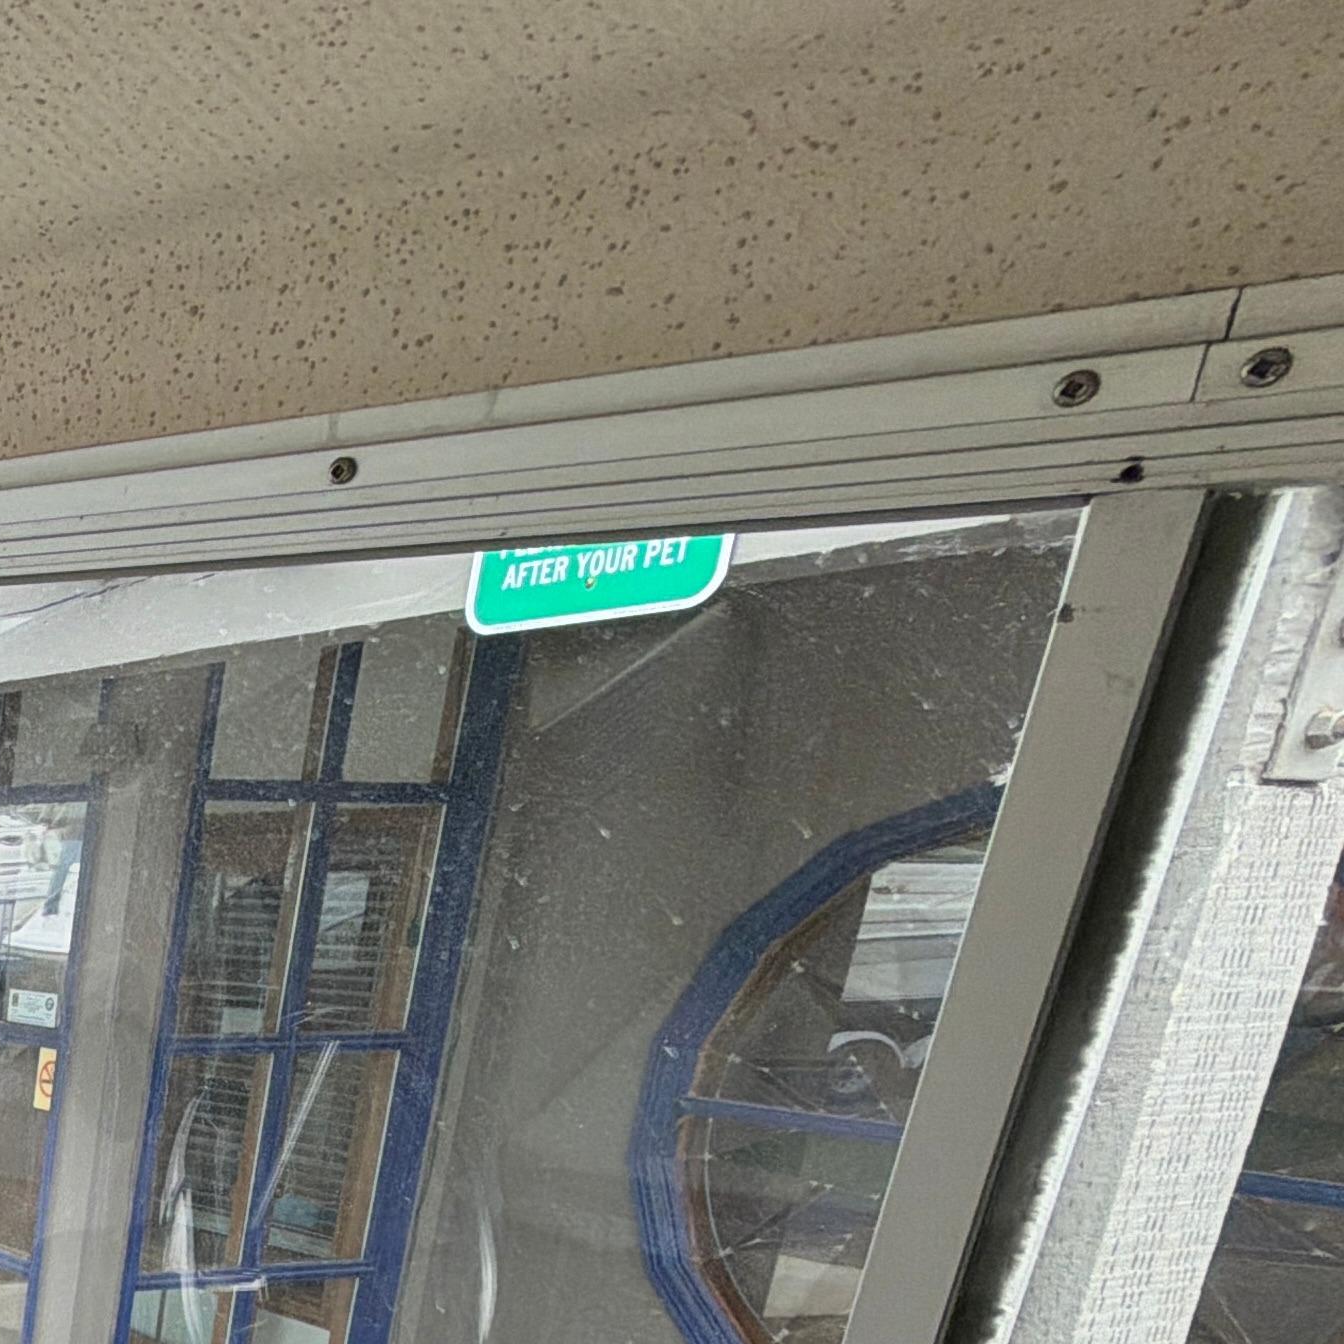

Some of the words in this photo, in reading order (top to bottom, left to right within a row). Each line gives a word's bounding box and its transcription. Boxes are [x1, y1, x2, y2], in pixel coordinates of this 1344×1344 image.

[501, 555, 569, 591] AFTER
[576, 541, 638, 579] YOUR
[643, 536, 691, 569] PET
